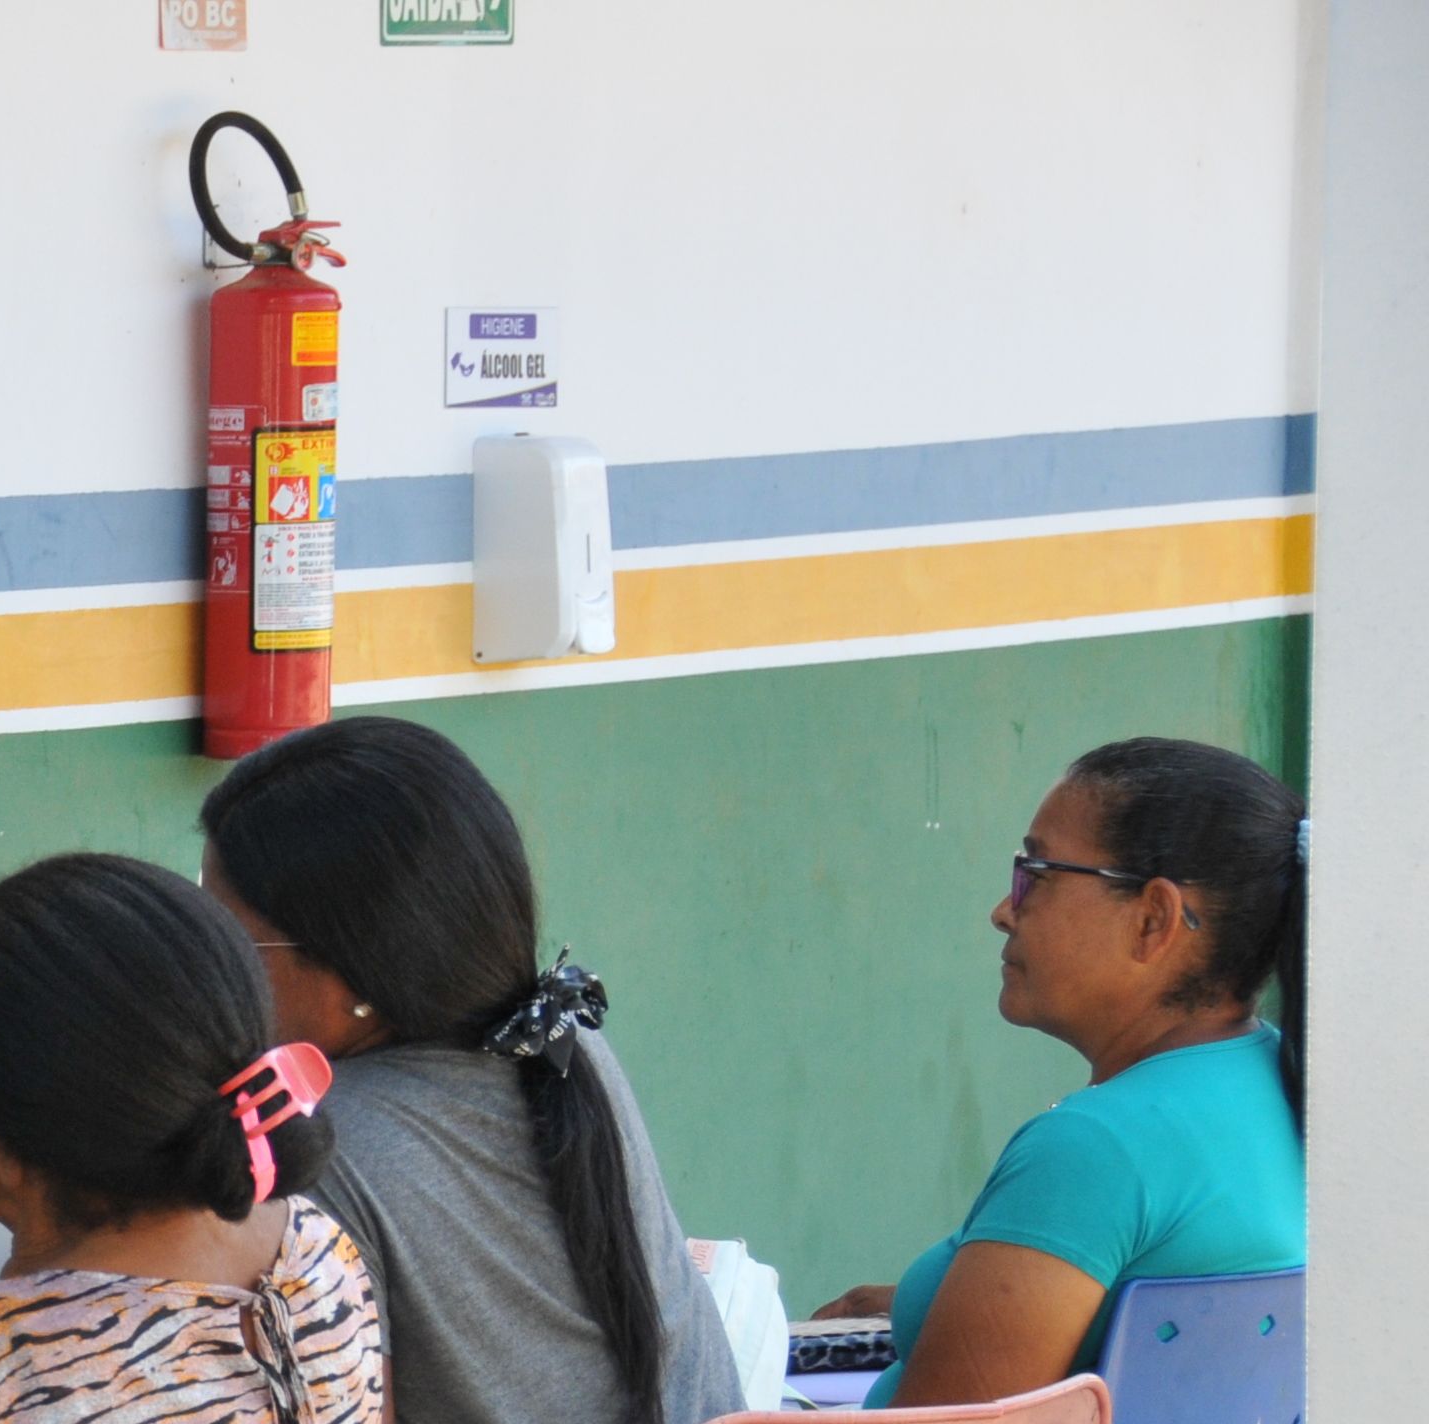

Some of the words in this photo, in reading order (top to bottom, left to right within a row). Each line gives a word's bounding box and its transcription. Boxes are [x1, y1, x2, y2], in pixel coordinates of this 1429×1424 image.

[205, 1, 237, 28] BC
[481, 317, 525, 336] HIGIENE
[481, 349, 523, 378] ÁLCOOL
[526, 354, 546, 378] GEL
